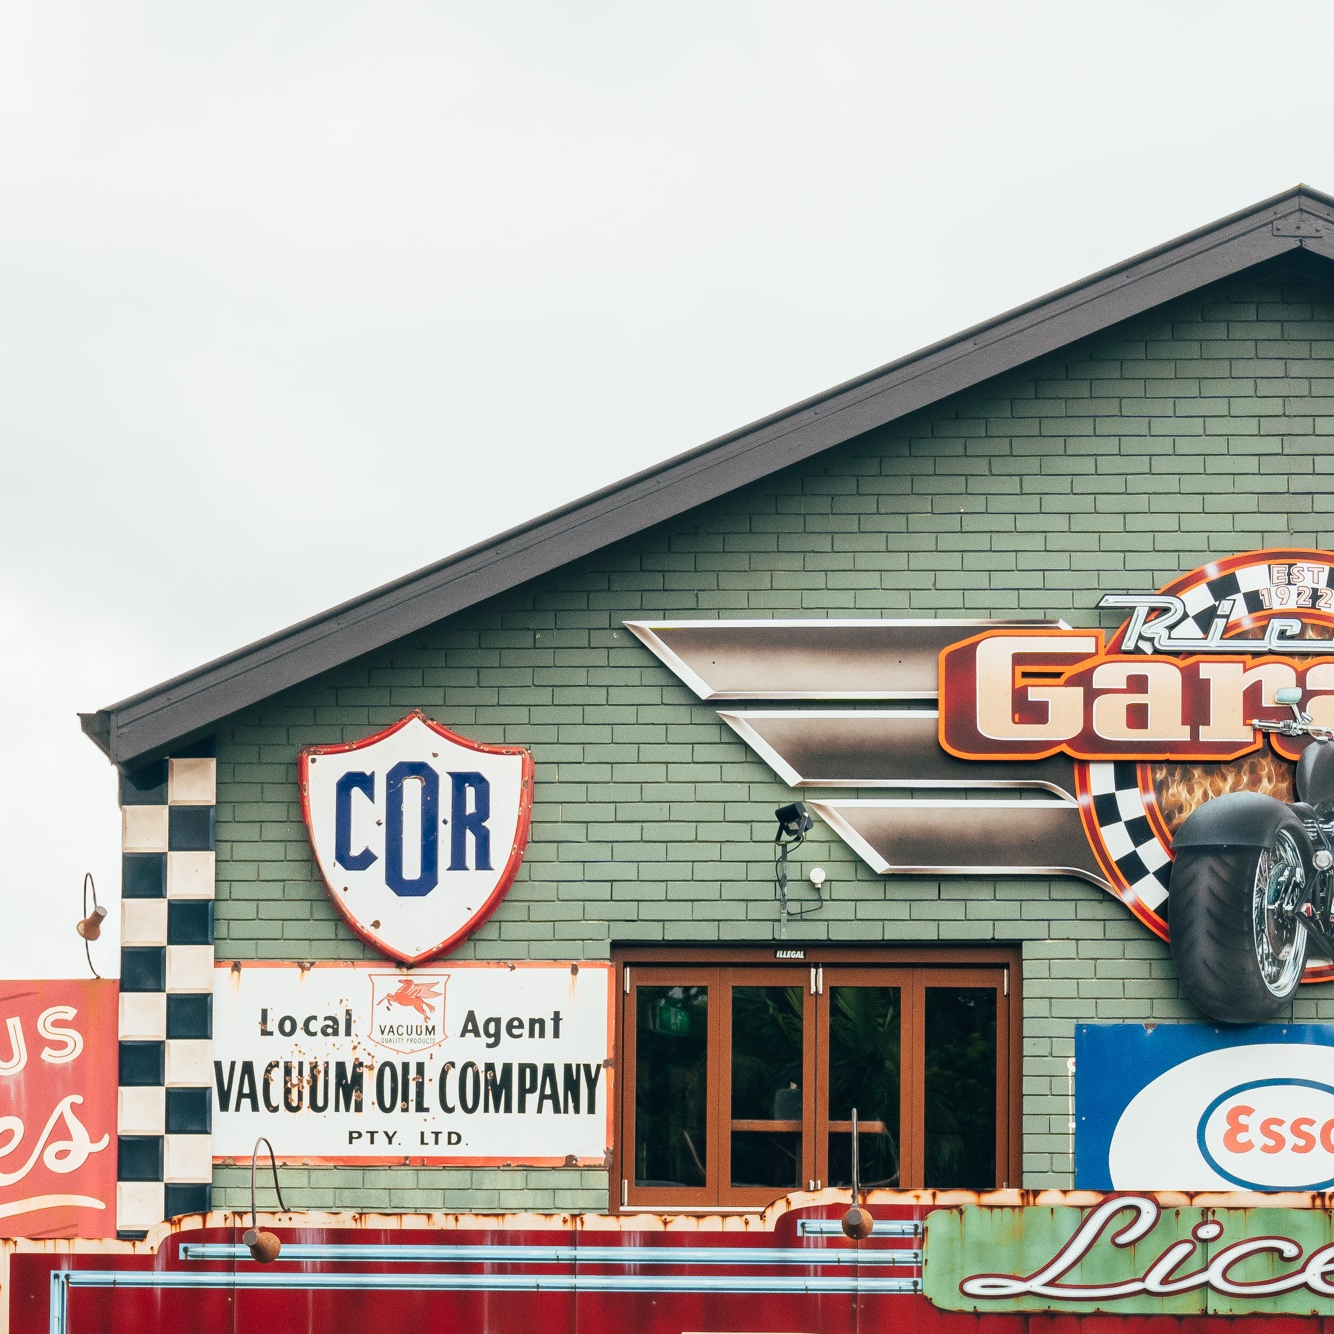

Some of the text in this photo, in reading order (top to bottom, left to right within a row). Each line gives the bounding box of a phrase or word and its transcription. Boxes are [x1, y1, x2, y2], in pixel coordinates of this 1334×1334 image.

[1271, 564, 1325, 585] EST
[1259, 586, 1334, 609] 1922
[776, 950, 805, 959] ILLEGAL
[260, 1008, 562, 1049] Local Agent
[379, 1024, 436, 1036] VACUUM
[214, 1060, 605, 1115] VACUUM OIL COMPANY
[348, 1131, 469, 1146] PTY. LTD.
